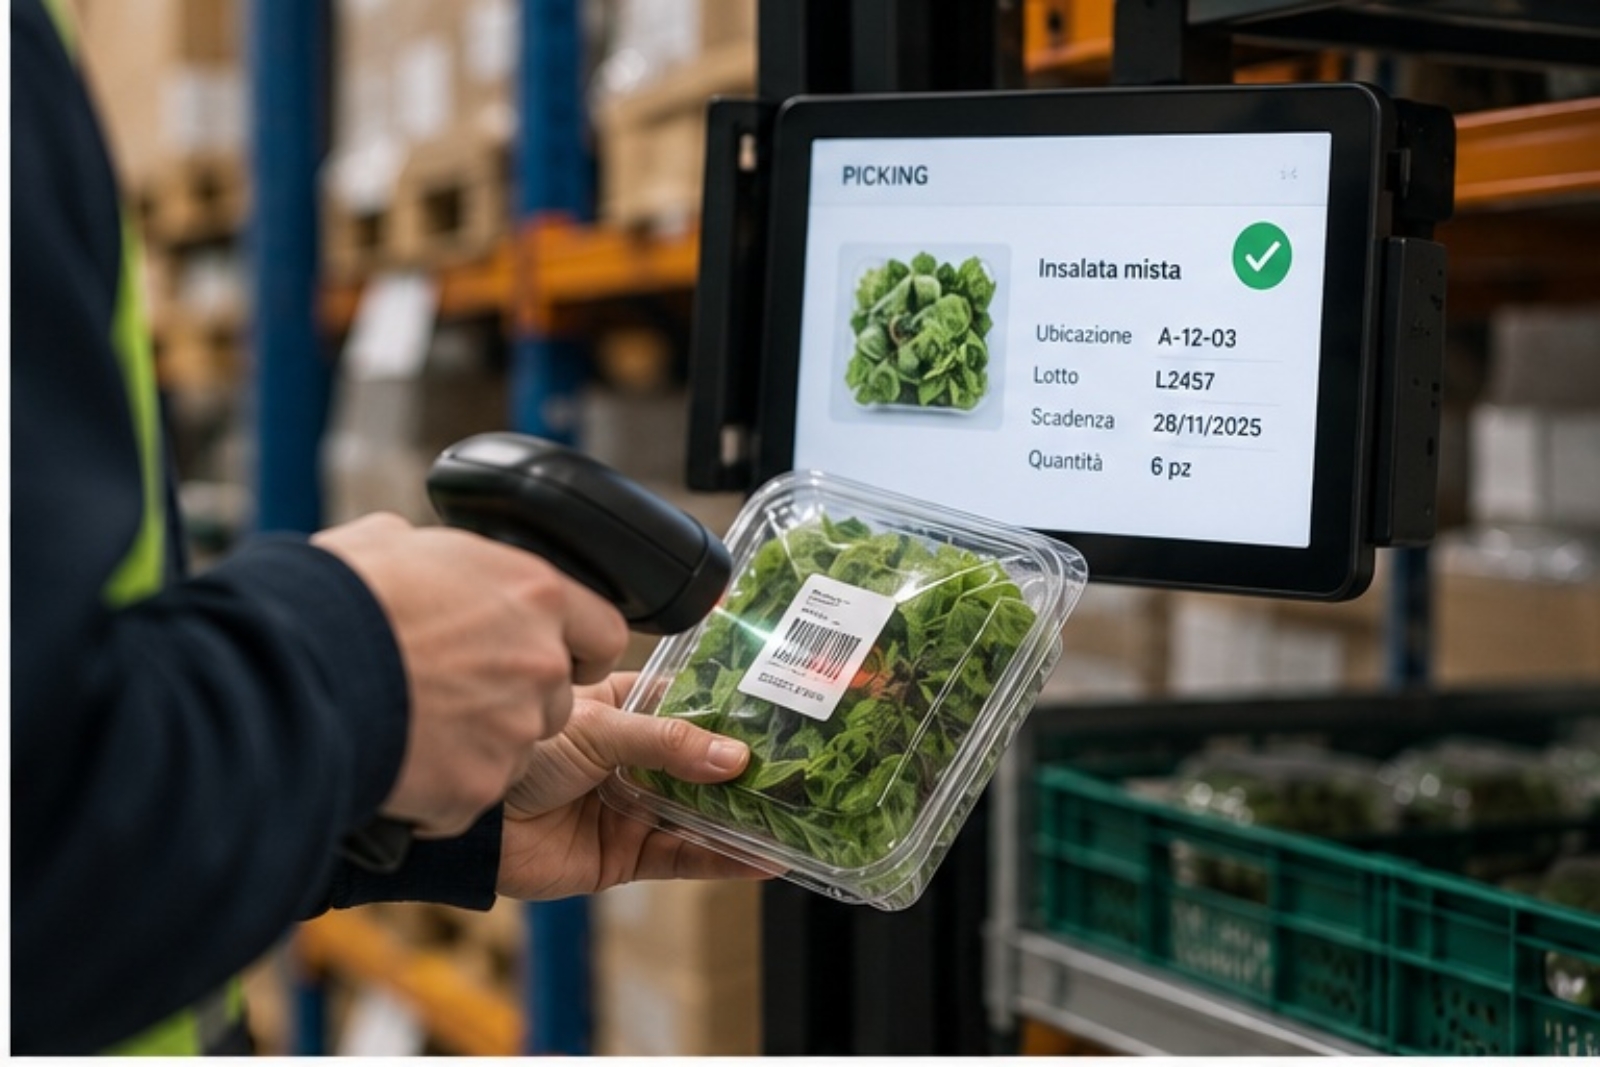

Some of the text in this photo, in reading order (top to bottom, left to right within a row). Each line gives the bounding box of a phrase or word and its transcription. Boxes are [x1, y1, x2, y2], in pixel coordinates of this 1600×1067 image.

[842, 165, 928, 186] PICKING
[1038, 258, 1182, 281] Insalata mista
[1036, 324, 1237, 348] Ubicazione A-12-03
[1033, 366, 1215, 391] Lotto L2457
[1031, 408, 1262, 437] Scadenza 28/11/2025
[1028, 450, 1192, 481] Quantità 6 pz
